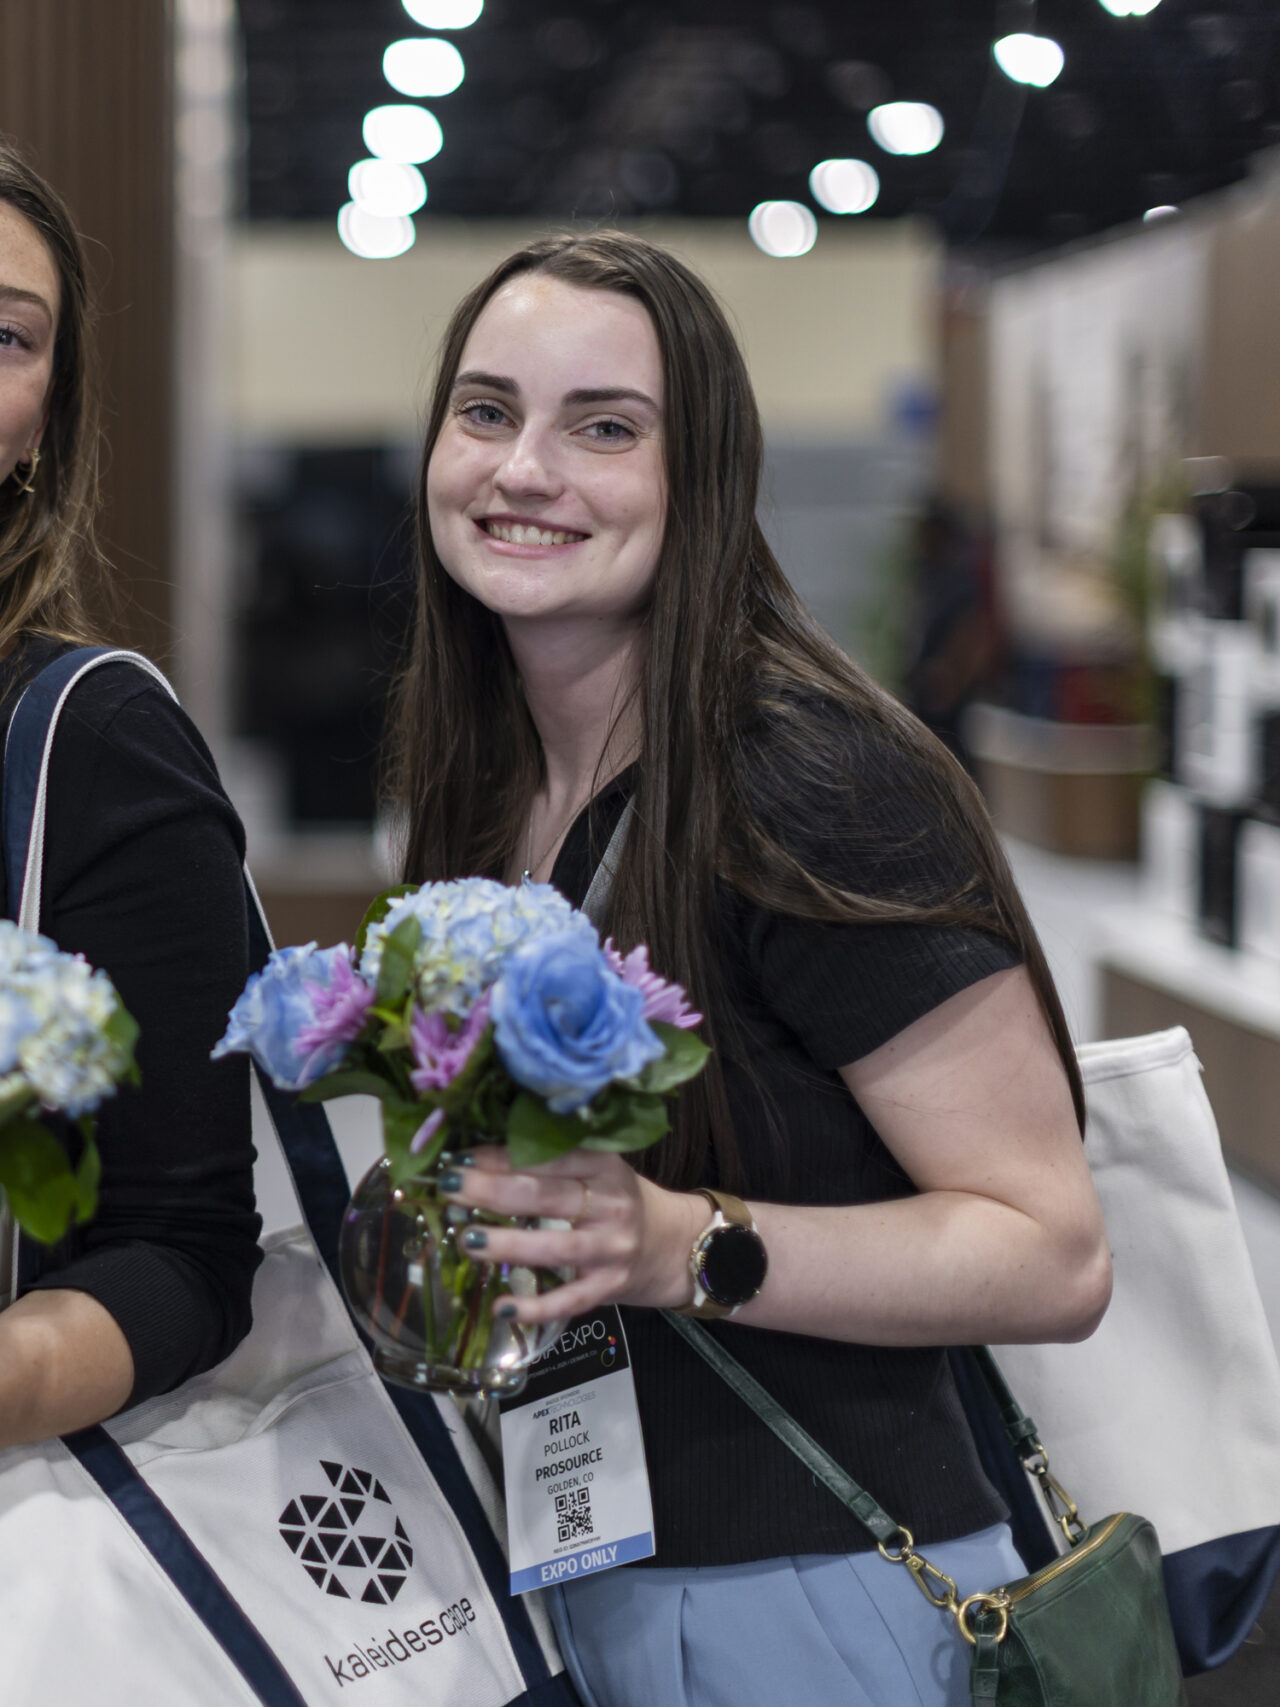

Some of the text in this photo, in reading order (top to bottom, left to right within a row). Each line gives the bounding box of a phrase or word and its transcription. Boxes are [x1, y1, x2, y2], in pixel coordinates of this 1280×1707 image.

[560, 1320, 606, 1353] EXPO
[549, 1411, 581, 1435] RITA
[544, 1430, 590, 1456] POLLOCK
[535, 1448, 603, 1481] PROSOURCE
[547, 1472, 594, 1495] GOLDEN, CO
[541, 1545, 618, 1582] EXPO ONLY
[324, 1598, 476, 1687] kaleidescape
